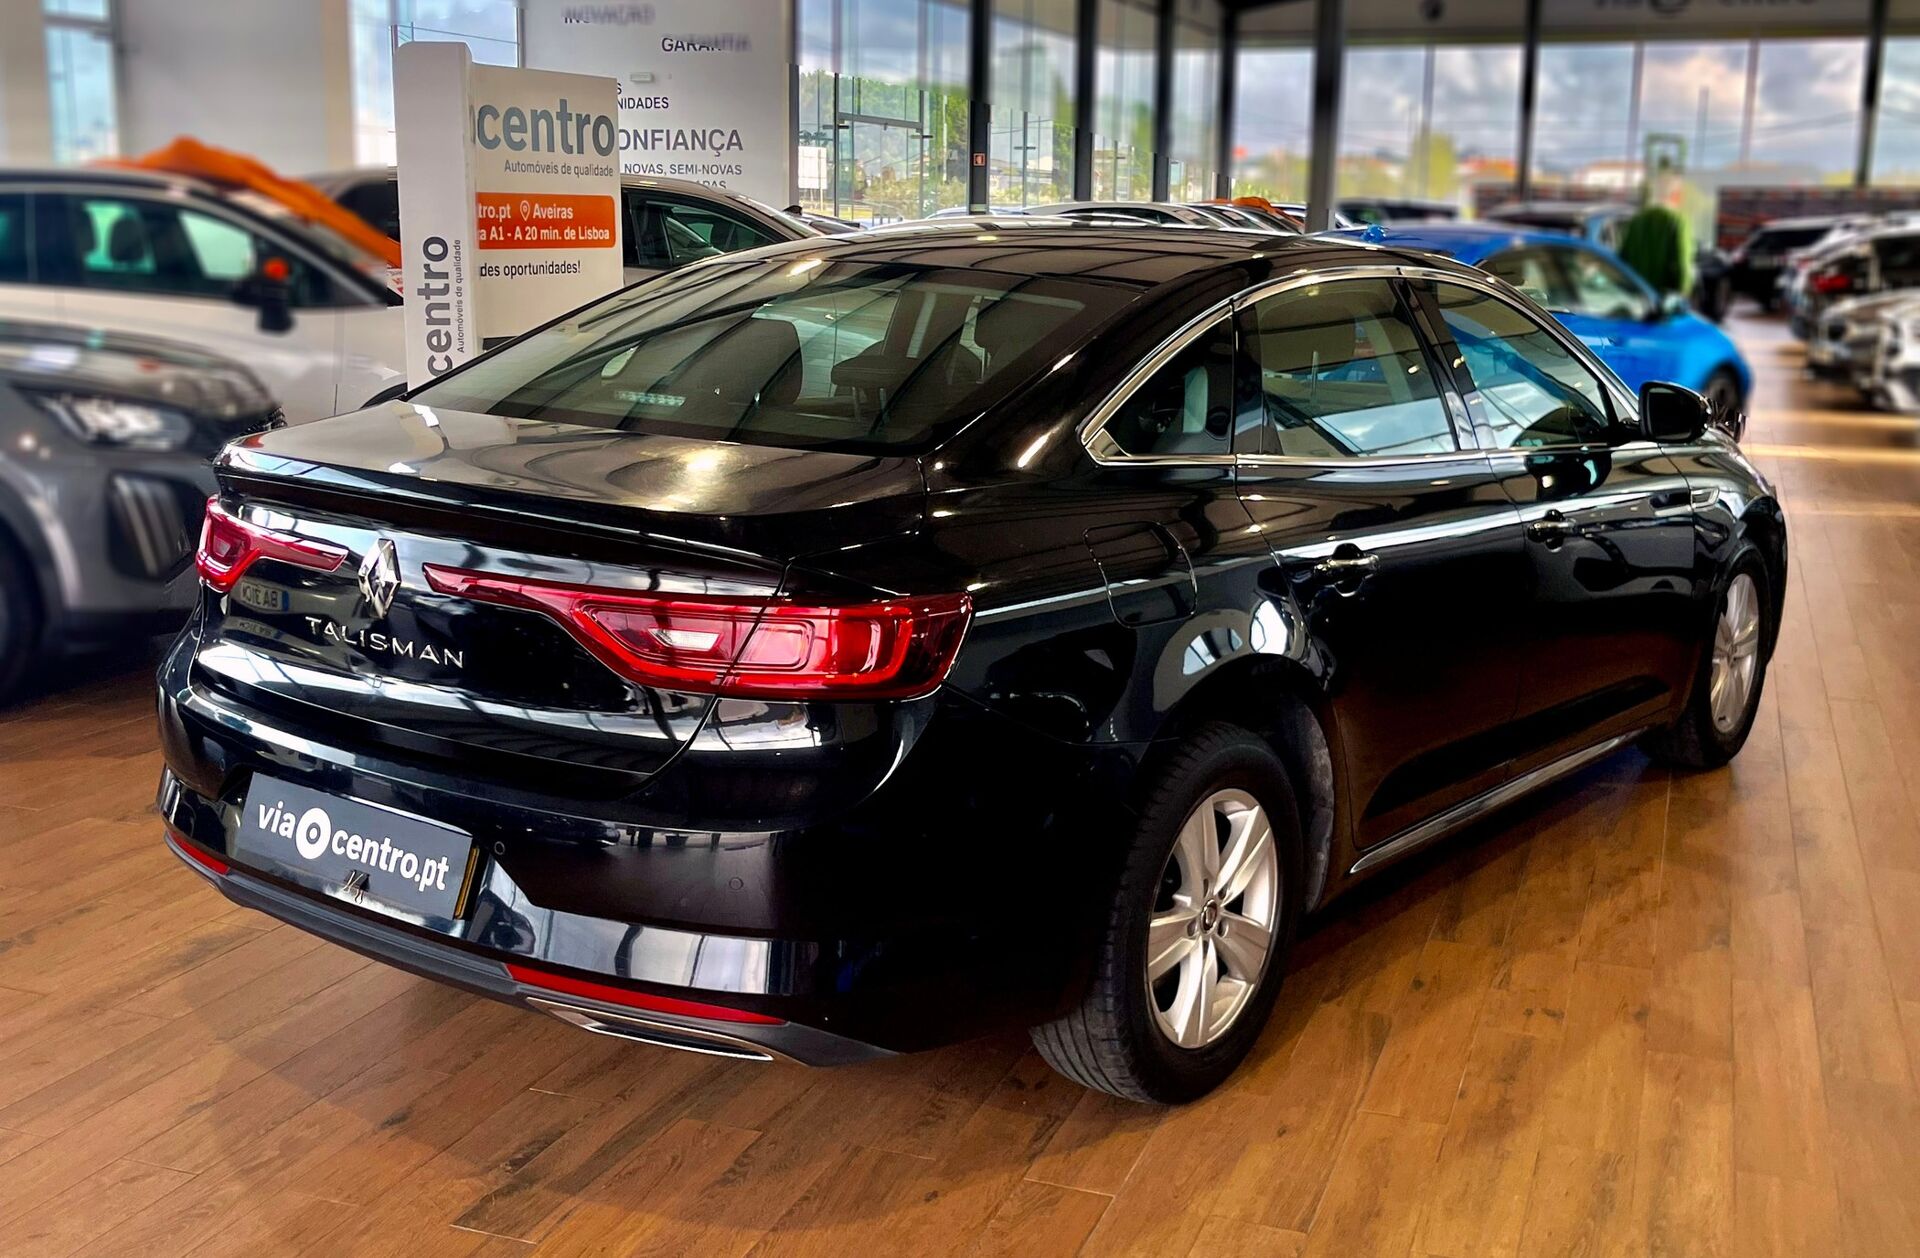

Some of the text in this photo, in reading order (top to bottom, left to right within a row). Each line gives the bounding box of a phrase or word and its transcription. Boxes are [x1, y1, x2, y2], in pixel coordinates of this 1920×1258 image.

[504, 160, 613, 178] Automóveis de qualidade
[624, 163, 742, 175] NOVAS, SEMI-NOVAS
[533, 203, 573, 219] Aveiras
[490, 226, 504, 241] A1
[514, 226, 522, 241] A
[525, 226, 538, 241] 20
[540, 226, 561, 241] min.
[564, 226, 576, 241] de
[578, 226, 610, 241] Lisboa
[503, 260, 581, 280] oportunidades!
[453, 240, 465, 353] Automóveis de qualidade
[417, 236, 453, 377] centro
[305, 616, 464, 669] TALISMAN
